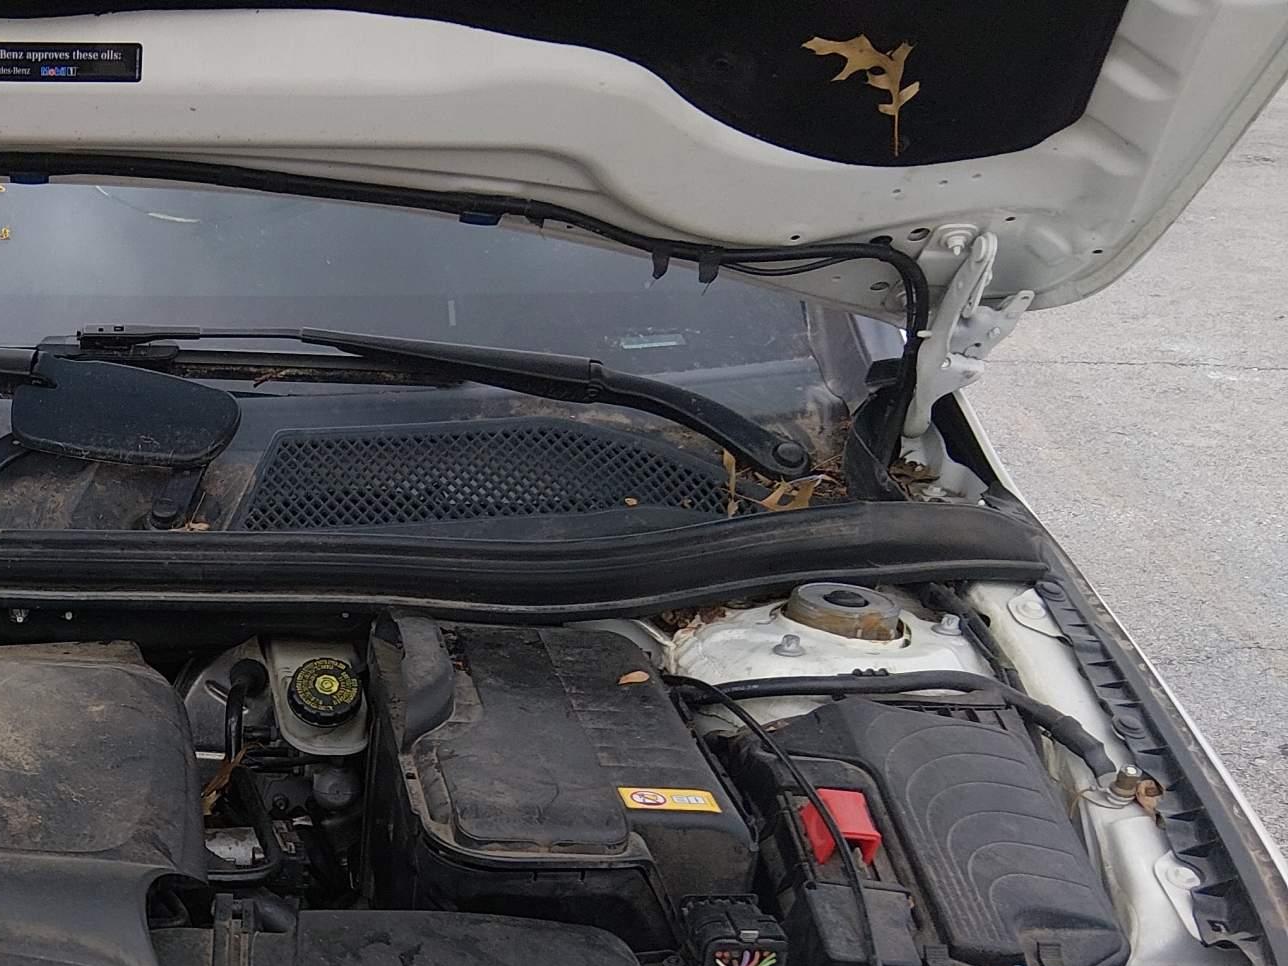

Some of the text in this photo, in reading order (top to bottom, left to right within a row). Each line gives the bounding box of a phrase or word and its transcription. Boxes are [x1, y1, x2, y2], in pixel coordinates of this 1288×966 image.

[26, 51, 70, 62] approves
[72, 49, 99, 60] these
[101, 49, 122, 60] oils:
